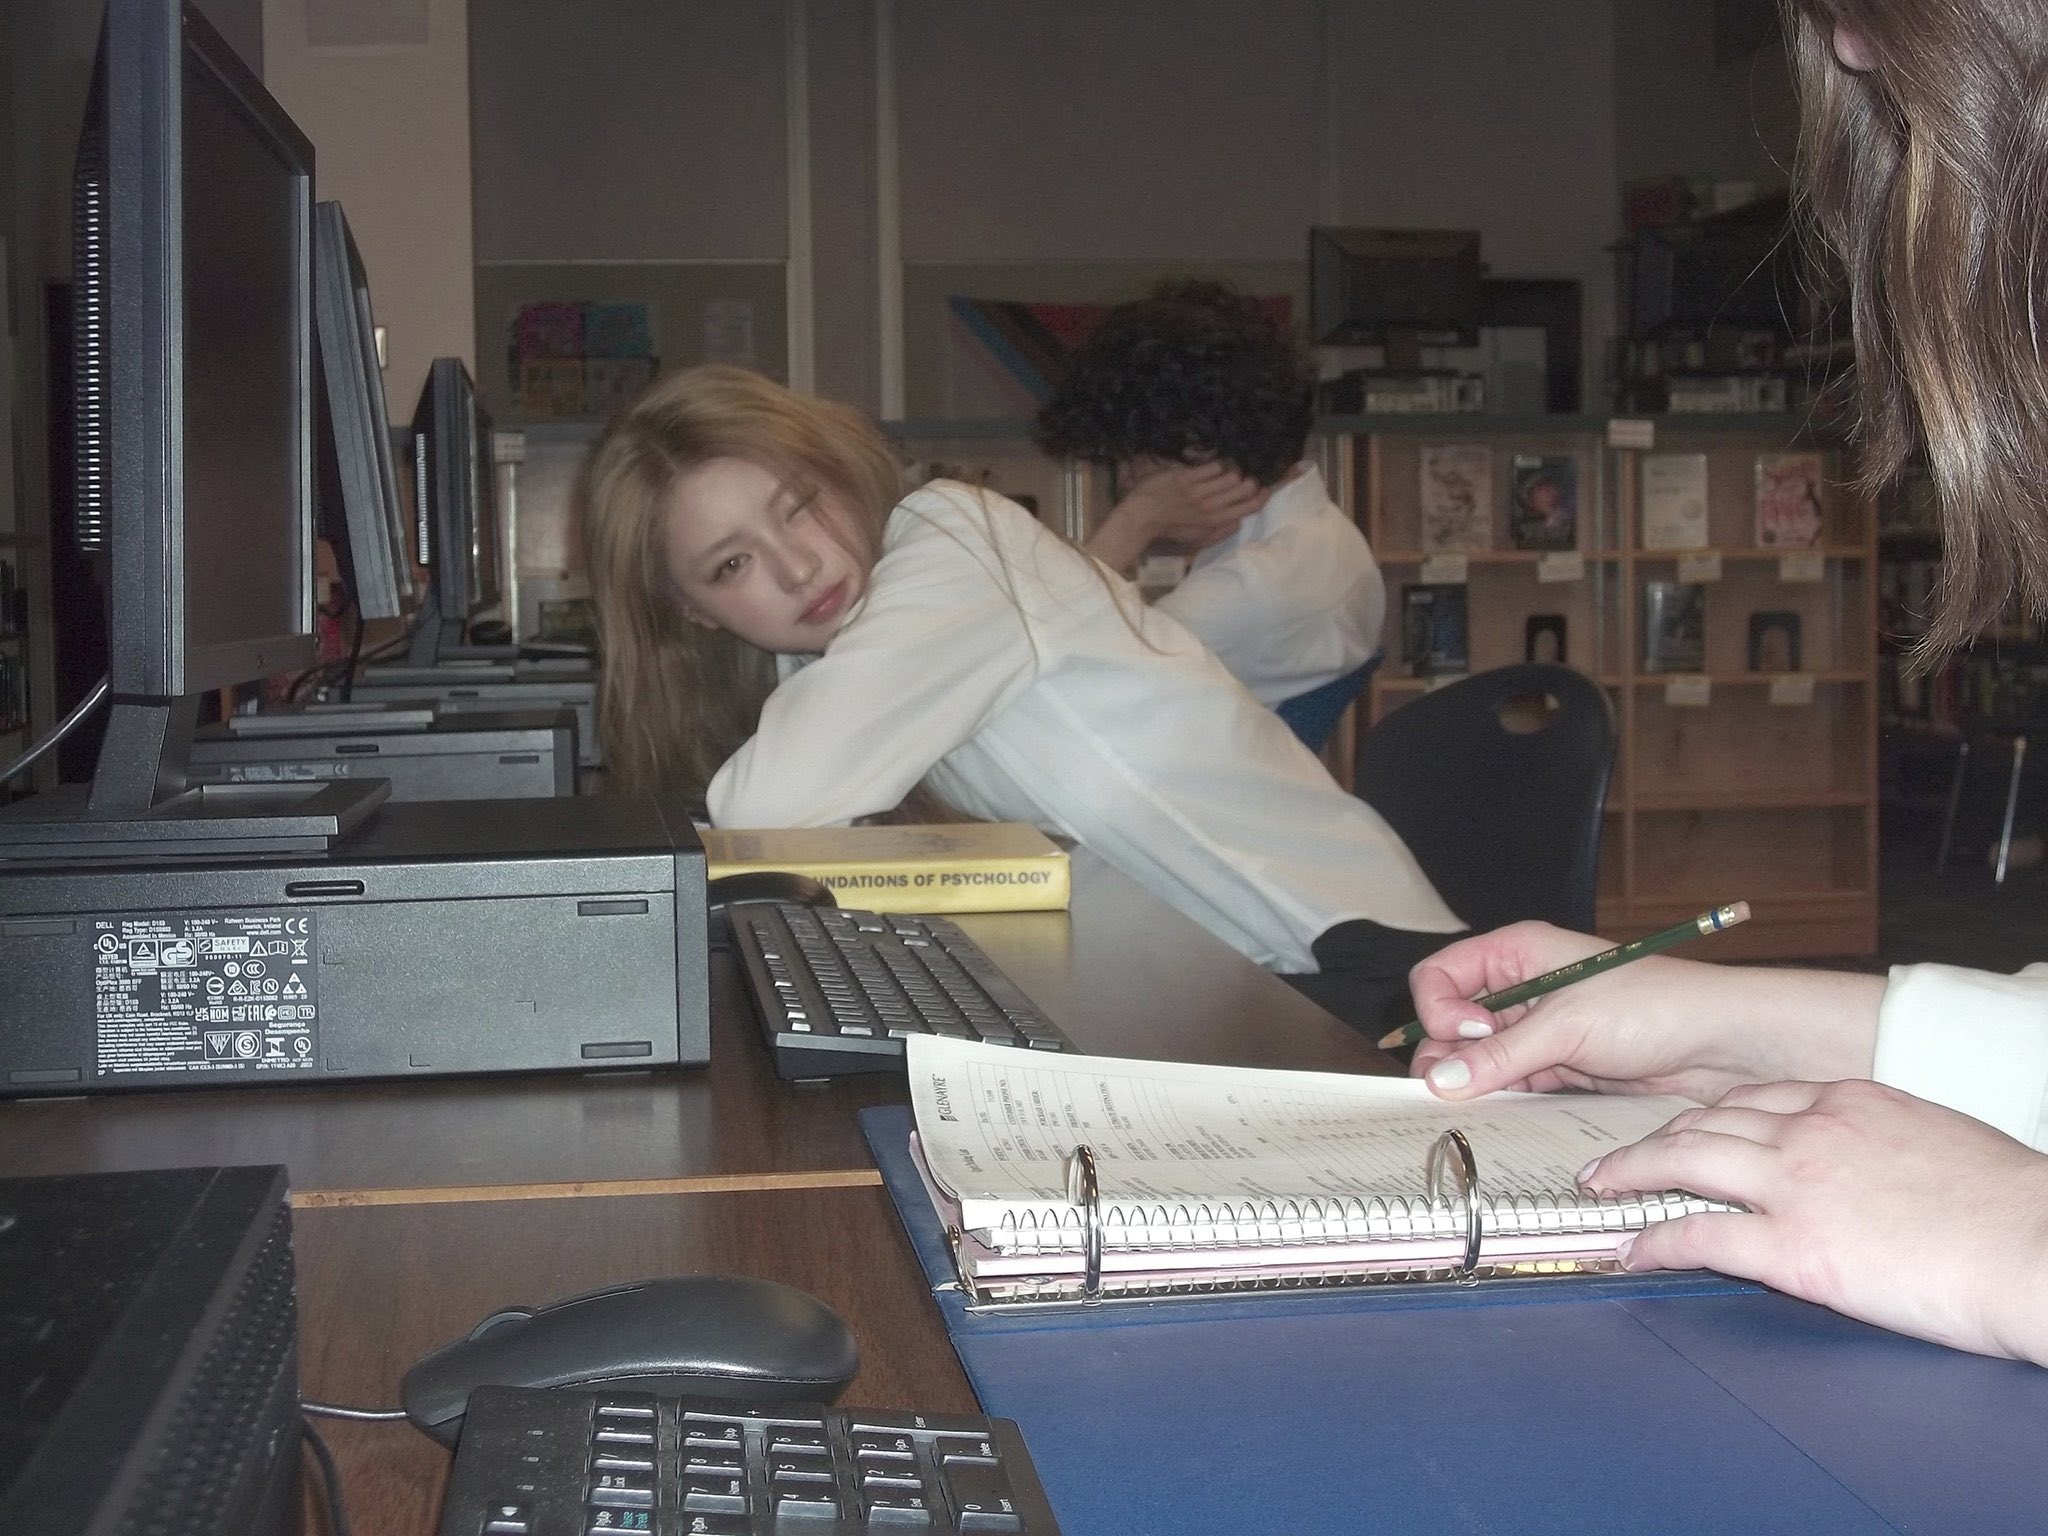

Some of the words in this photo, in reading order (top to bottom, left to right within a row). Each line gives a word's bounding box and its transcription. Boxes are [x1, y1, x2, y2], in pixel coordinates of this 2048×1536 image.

[814, 874, 909, 889] NDATIONS
[913, 874, 935, 888] OF
[940, 872, 1052, 886] PSYCHOLOGY
[285, 918, 308, 934] CE
[934, 1076, 952, 1115] GLENAYRE
